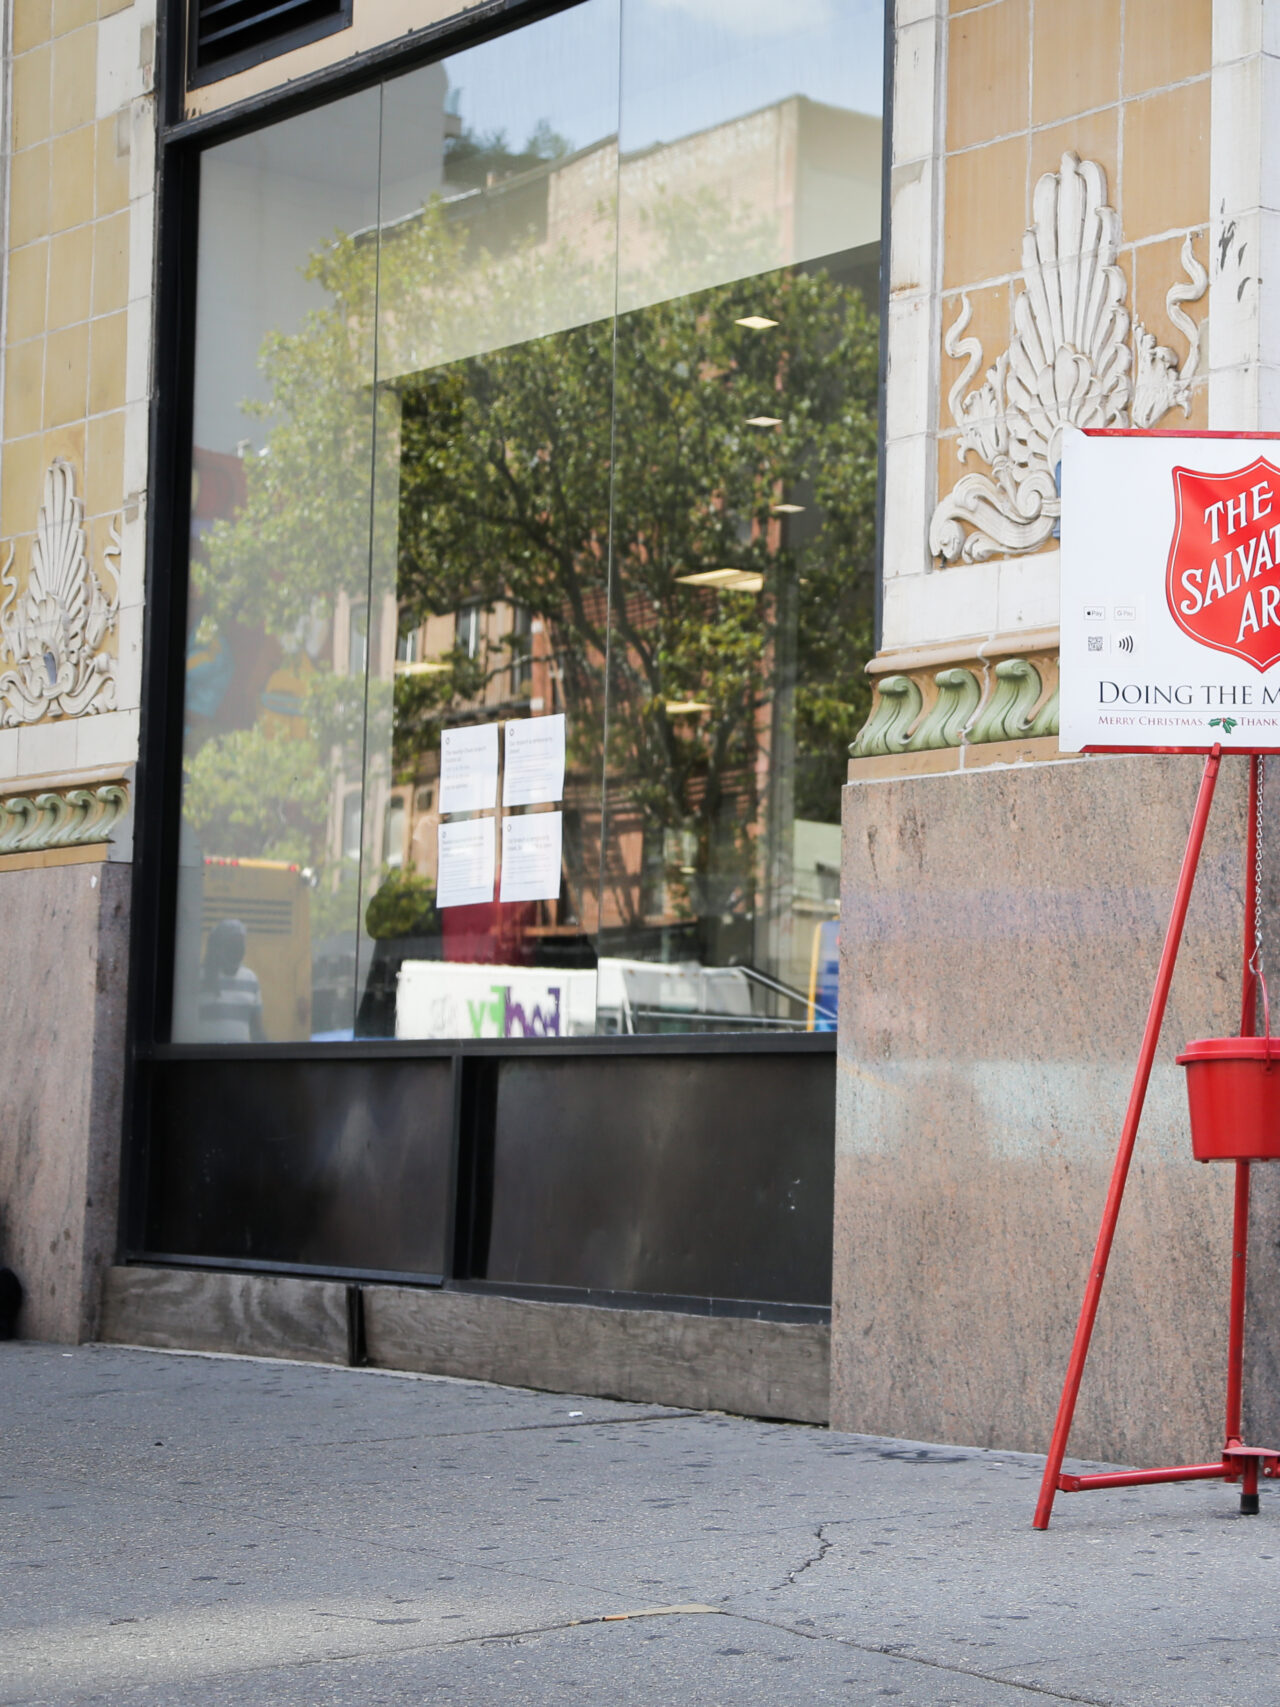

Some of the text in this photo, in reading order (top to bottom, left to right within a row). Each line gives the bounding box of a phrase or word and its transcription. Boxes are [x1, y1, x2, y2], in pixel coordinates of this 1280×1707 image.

[1203, 480, 1274, 544] THE
[1098, 680, 1193, 706] DOING
[1200, 685, 1253, 706] THE
[1098, 715, 1135, 727] MERRY
[1240, 716, 1279, 728] THANK
